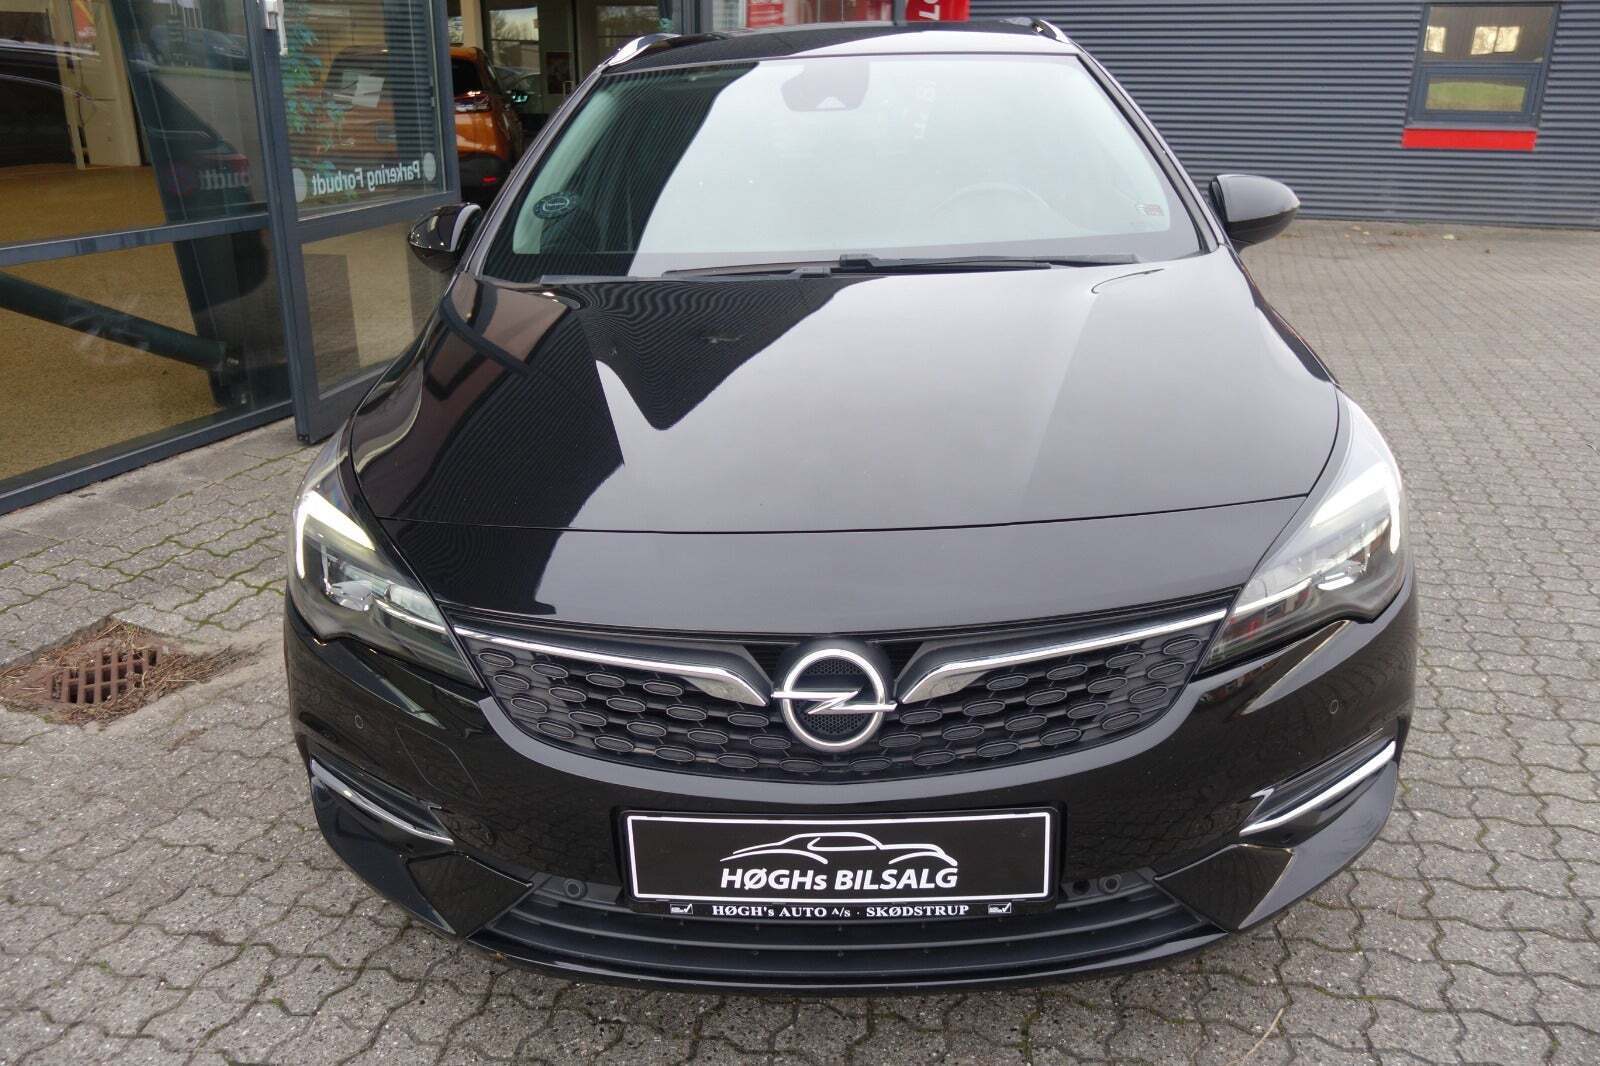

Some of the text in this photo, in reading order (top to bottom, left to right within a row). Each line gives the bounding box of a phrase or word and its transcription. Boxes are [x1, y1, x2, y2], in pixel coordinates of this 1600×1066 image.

[720, 867, 959, 891] HØGHs BILSALG
[711, 904, 775, 917] HØGH's
[778, 906, 828, 918] AUTO
[866, 904, 970, 918] SKØDSTRUP
